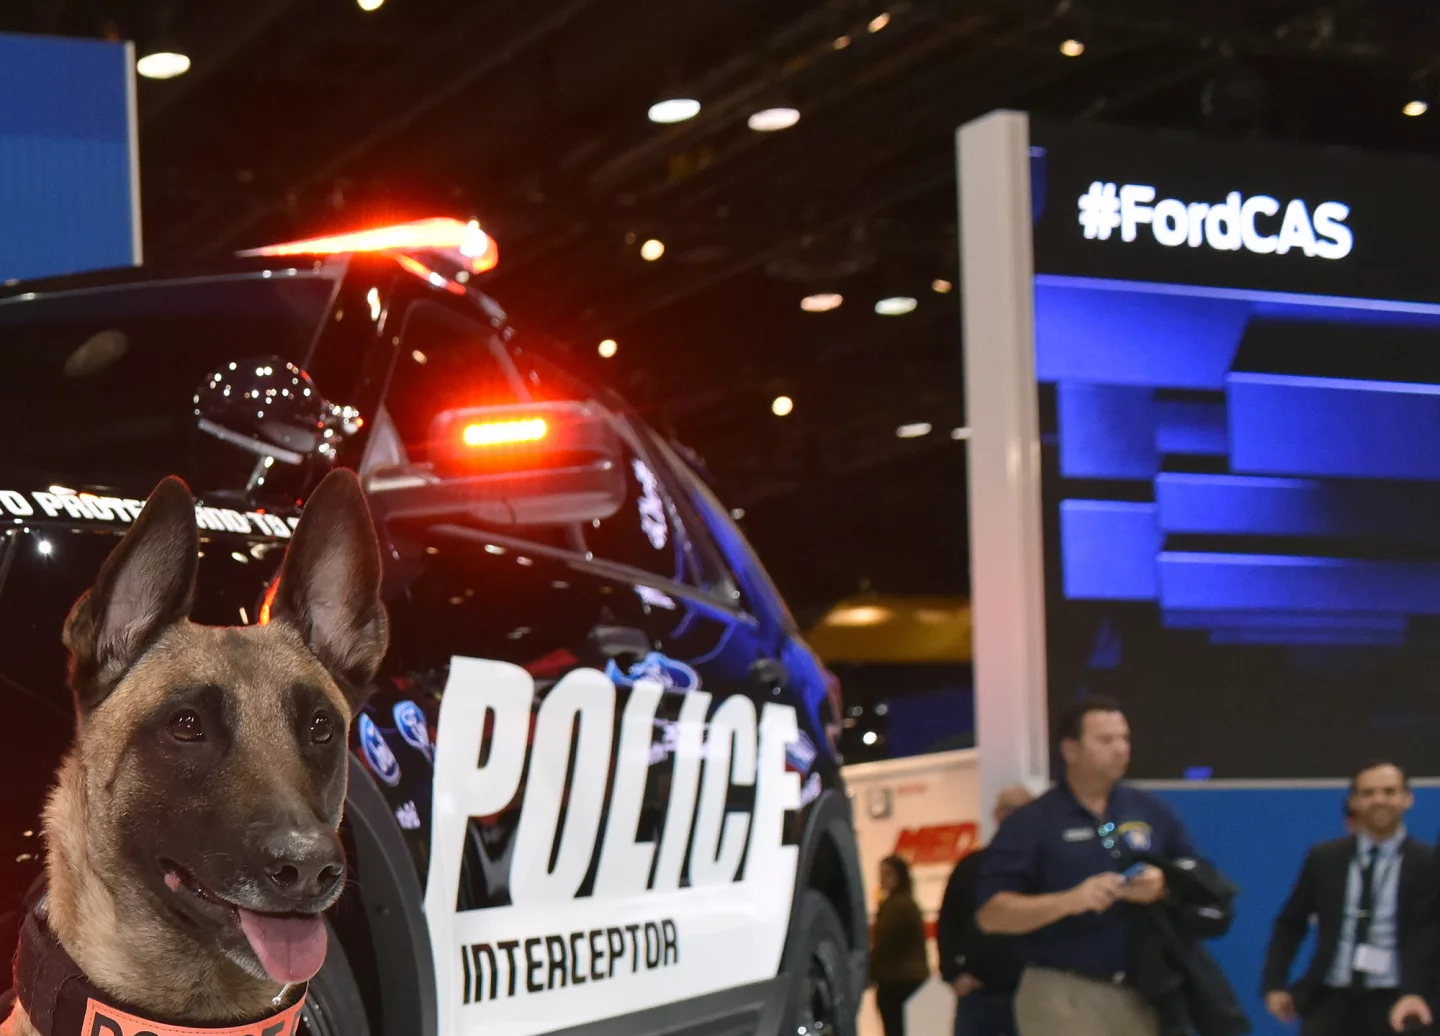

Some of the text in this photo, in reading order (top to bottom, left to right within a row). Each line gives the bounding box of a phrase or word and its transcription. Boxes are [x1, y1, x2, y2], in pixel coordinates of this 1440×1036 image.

[1077, 180, 1354, 260] #FordCAS
[31, 490, 147, 522] PROTE
[438, 655, 802, 912] POLICE
[461, 919, 680, 1005] INTERCEPTOR
